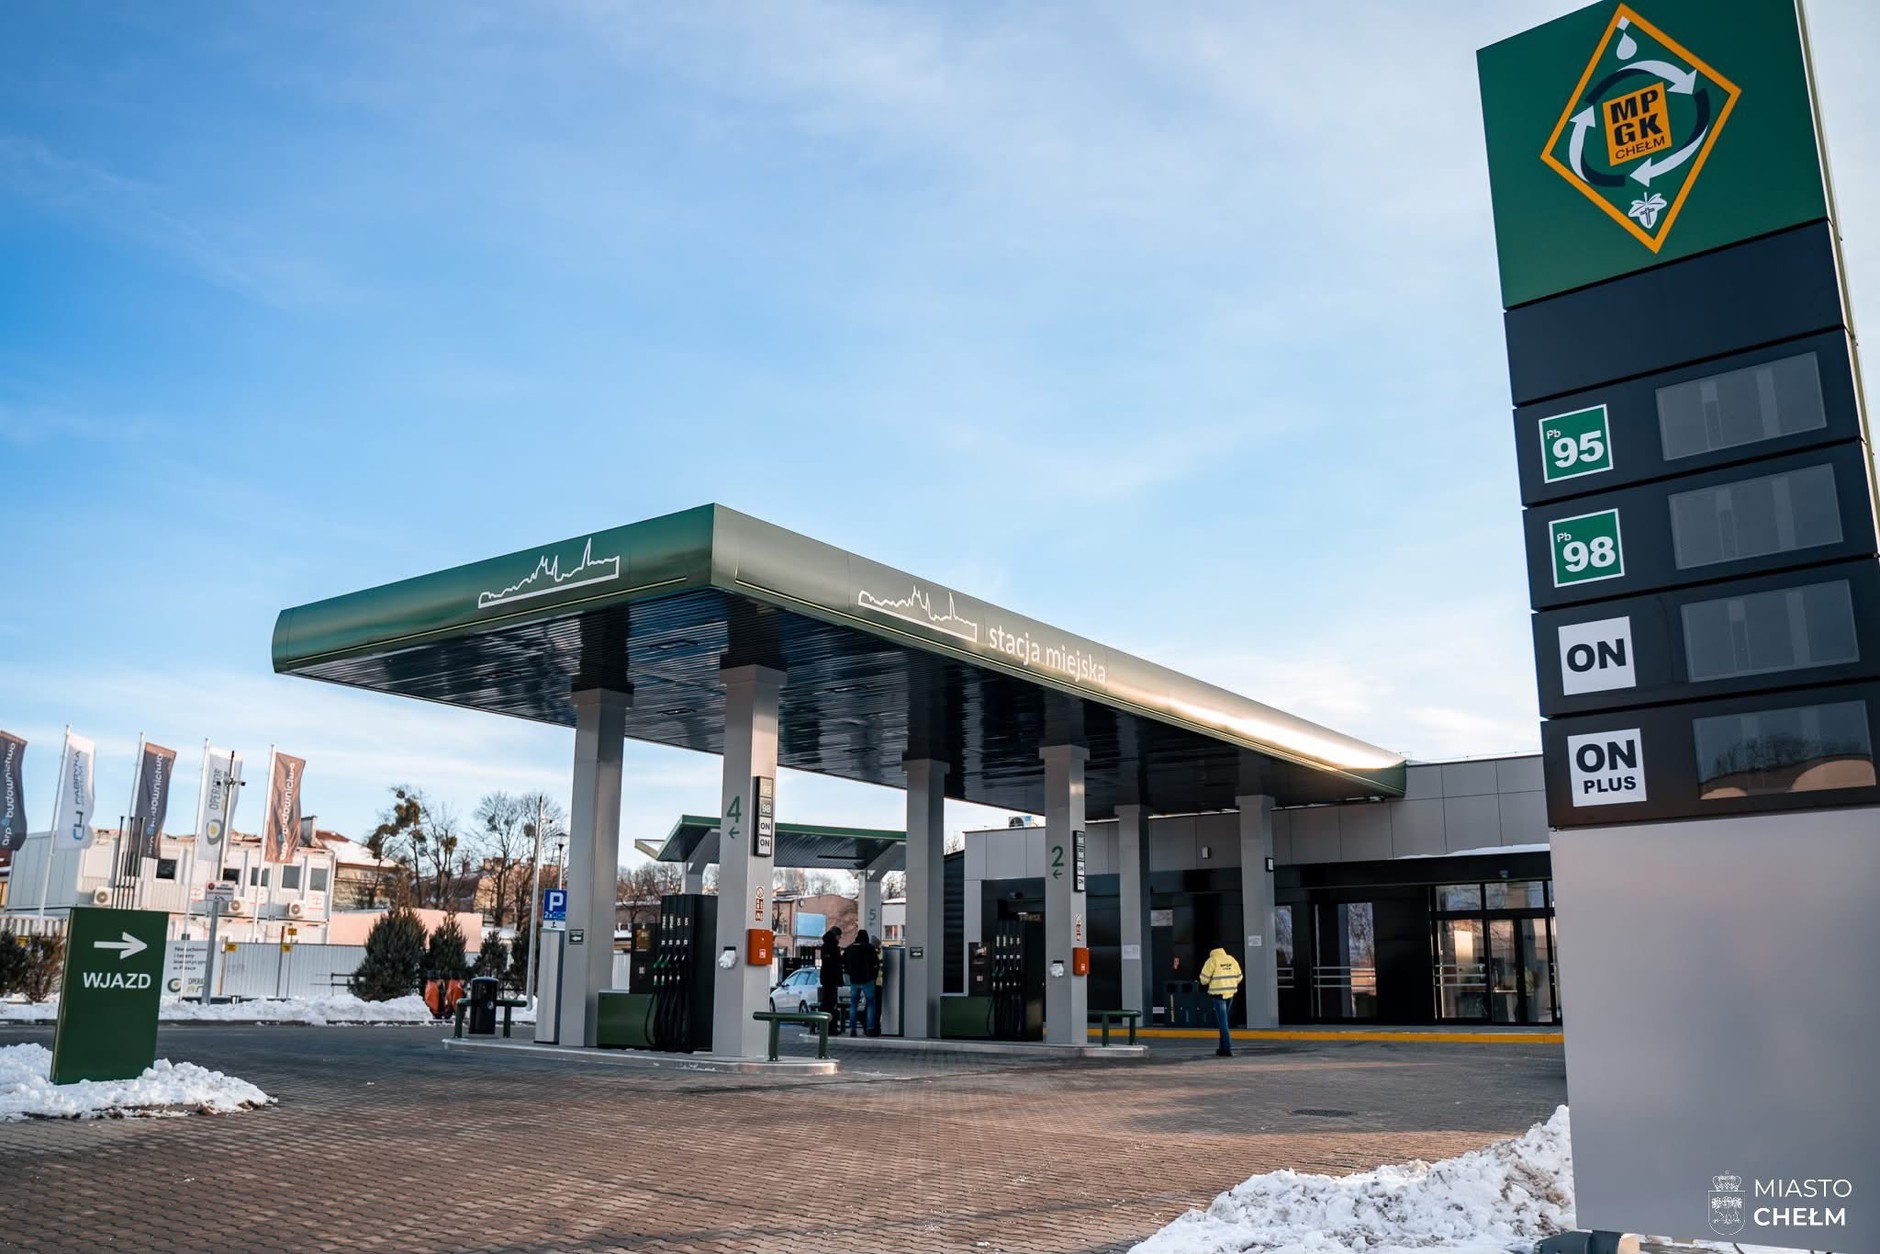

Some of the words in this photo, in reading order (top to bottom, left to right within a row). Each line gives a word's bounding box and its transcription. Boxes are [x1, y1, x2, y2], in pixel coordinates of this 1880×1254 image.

[1609, 89, 1661, 125] MP
[1613, 113, 1663, 147] GK
[1615, 136, 1666, 160] CHEŁM
[1547, 429, 1561, 440] Pb
[1552, 430, 1605, 468] 95
[1557, 532, 1572, 543] Pb
[1562, 536, 1616, 573] 98
[989, 625, 1041, 666] stacja
[1046, 644, 1107, 684] miejska
[1566, 638, 1628, 673] ON
[1575, 739, 1638, 773] ON
[5, 742, 17, 818] budownictwo
[1583, 775, 1637, 795] PLUS
[726, 795, 742, 824] 4
[762, 804, 771, 814] 98
[760, 822, 770, 830] ON
[760, 838, 770, 847] ON
[1051, 845, 1064, 868] 2
[548, 891, 564, 911] P
[869, 908, 877, 921] 5
[83, 972, 152, 990] WJAZD
